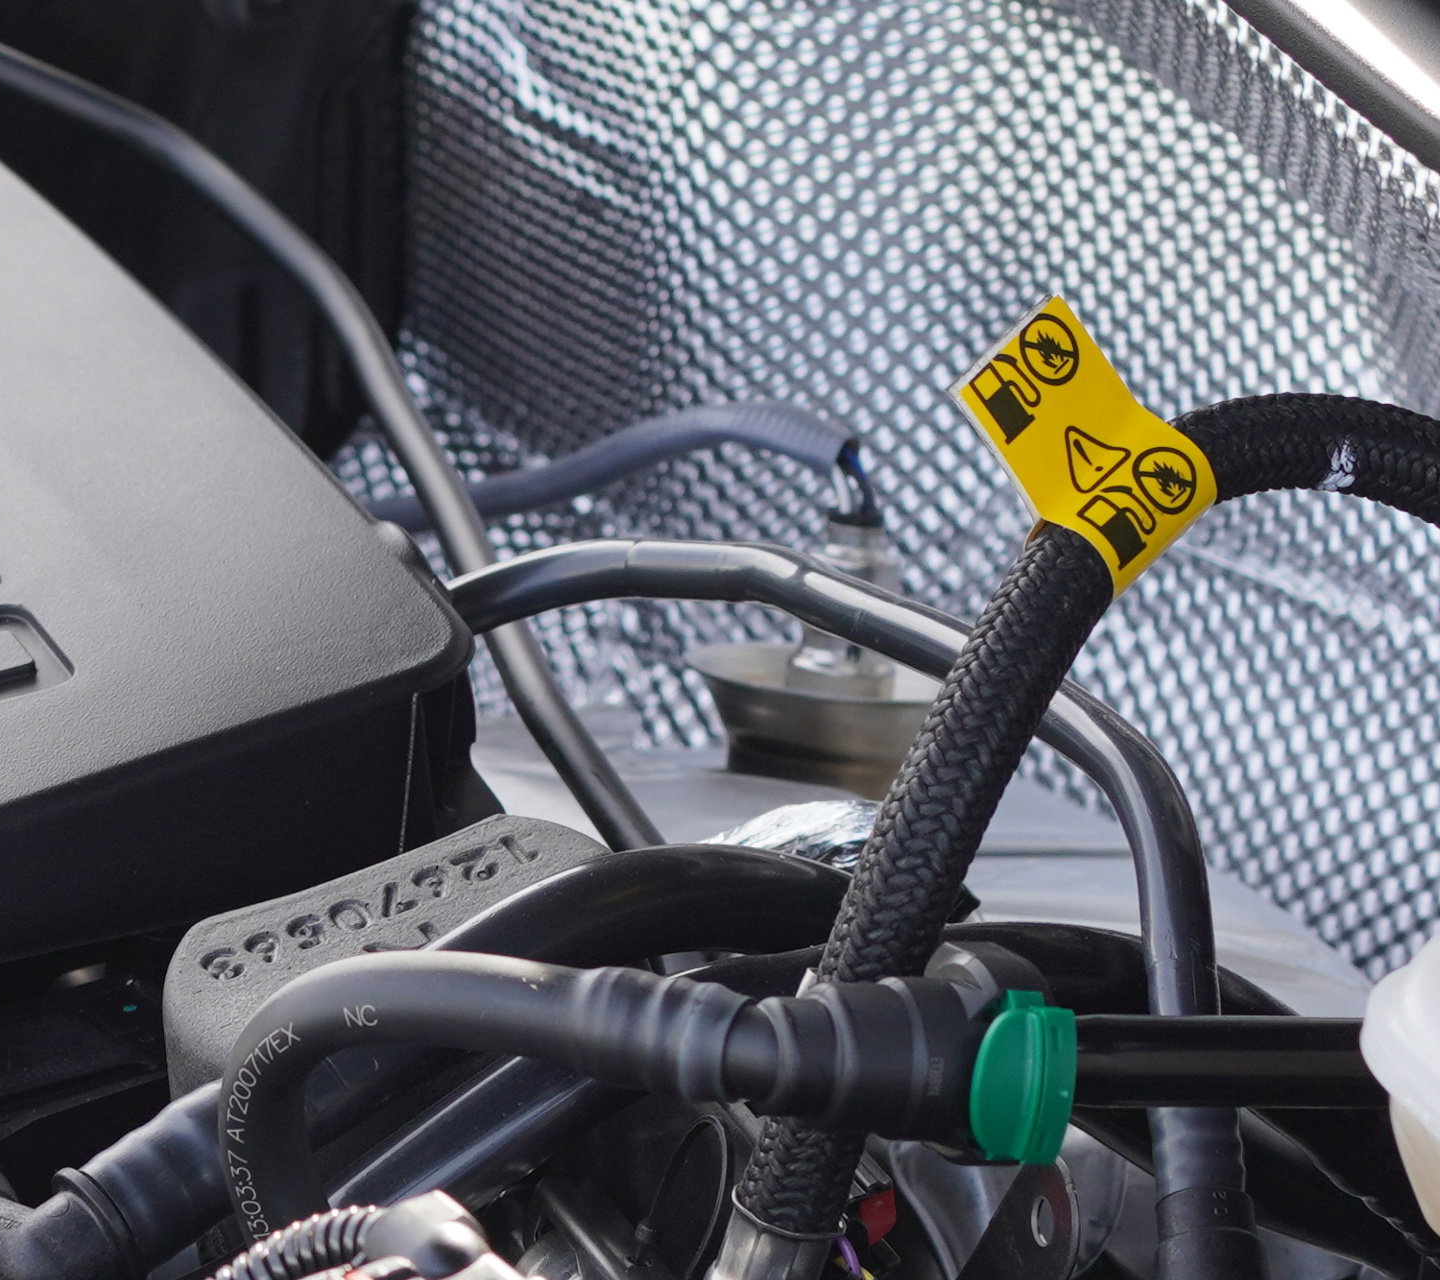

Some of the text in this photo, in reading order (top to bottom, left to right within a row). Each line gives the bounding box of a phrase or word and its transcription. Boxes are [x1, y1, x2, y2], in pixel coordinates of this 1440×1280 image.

[227, 1004, 379, 1241] 13:03:37 AT200717EX NC
